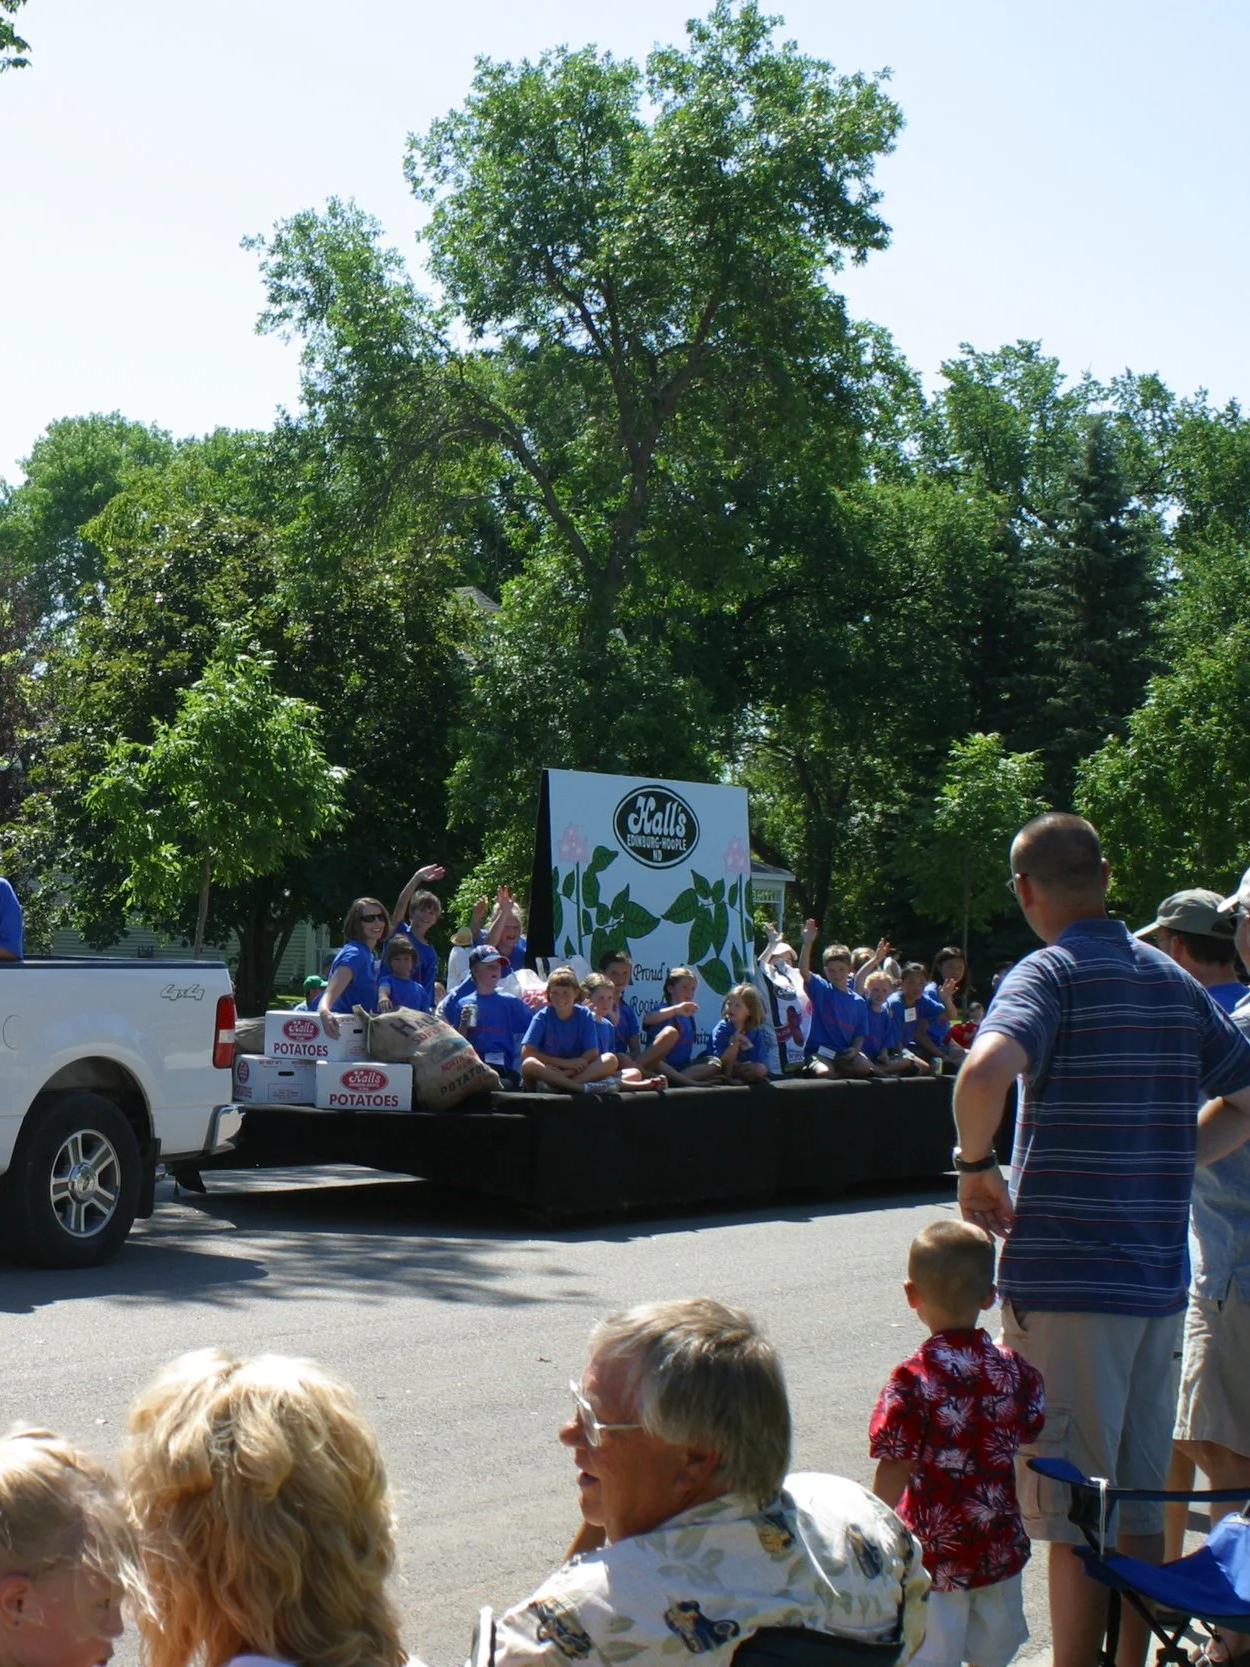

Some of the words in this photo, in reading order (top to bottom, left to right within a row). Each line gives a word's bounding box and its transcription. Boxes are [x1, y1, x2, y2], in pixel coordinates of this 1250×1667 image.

[652, 849, 663, 862] ND
[633, 962, 665, 981] Proud
[160, 984, 205, 1001] 4x4
[288, 1020, 315, 1033] Halls
[273, 1042, 328, 1057] POTATOES
[349, 1070, 382, 1084] Halls
[329, 1093, 399, 1107] POTATOES
